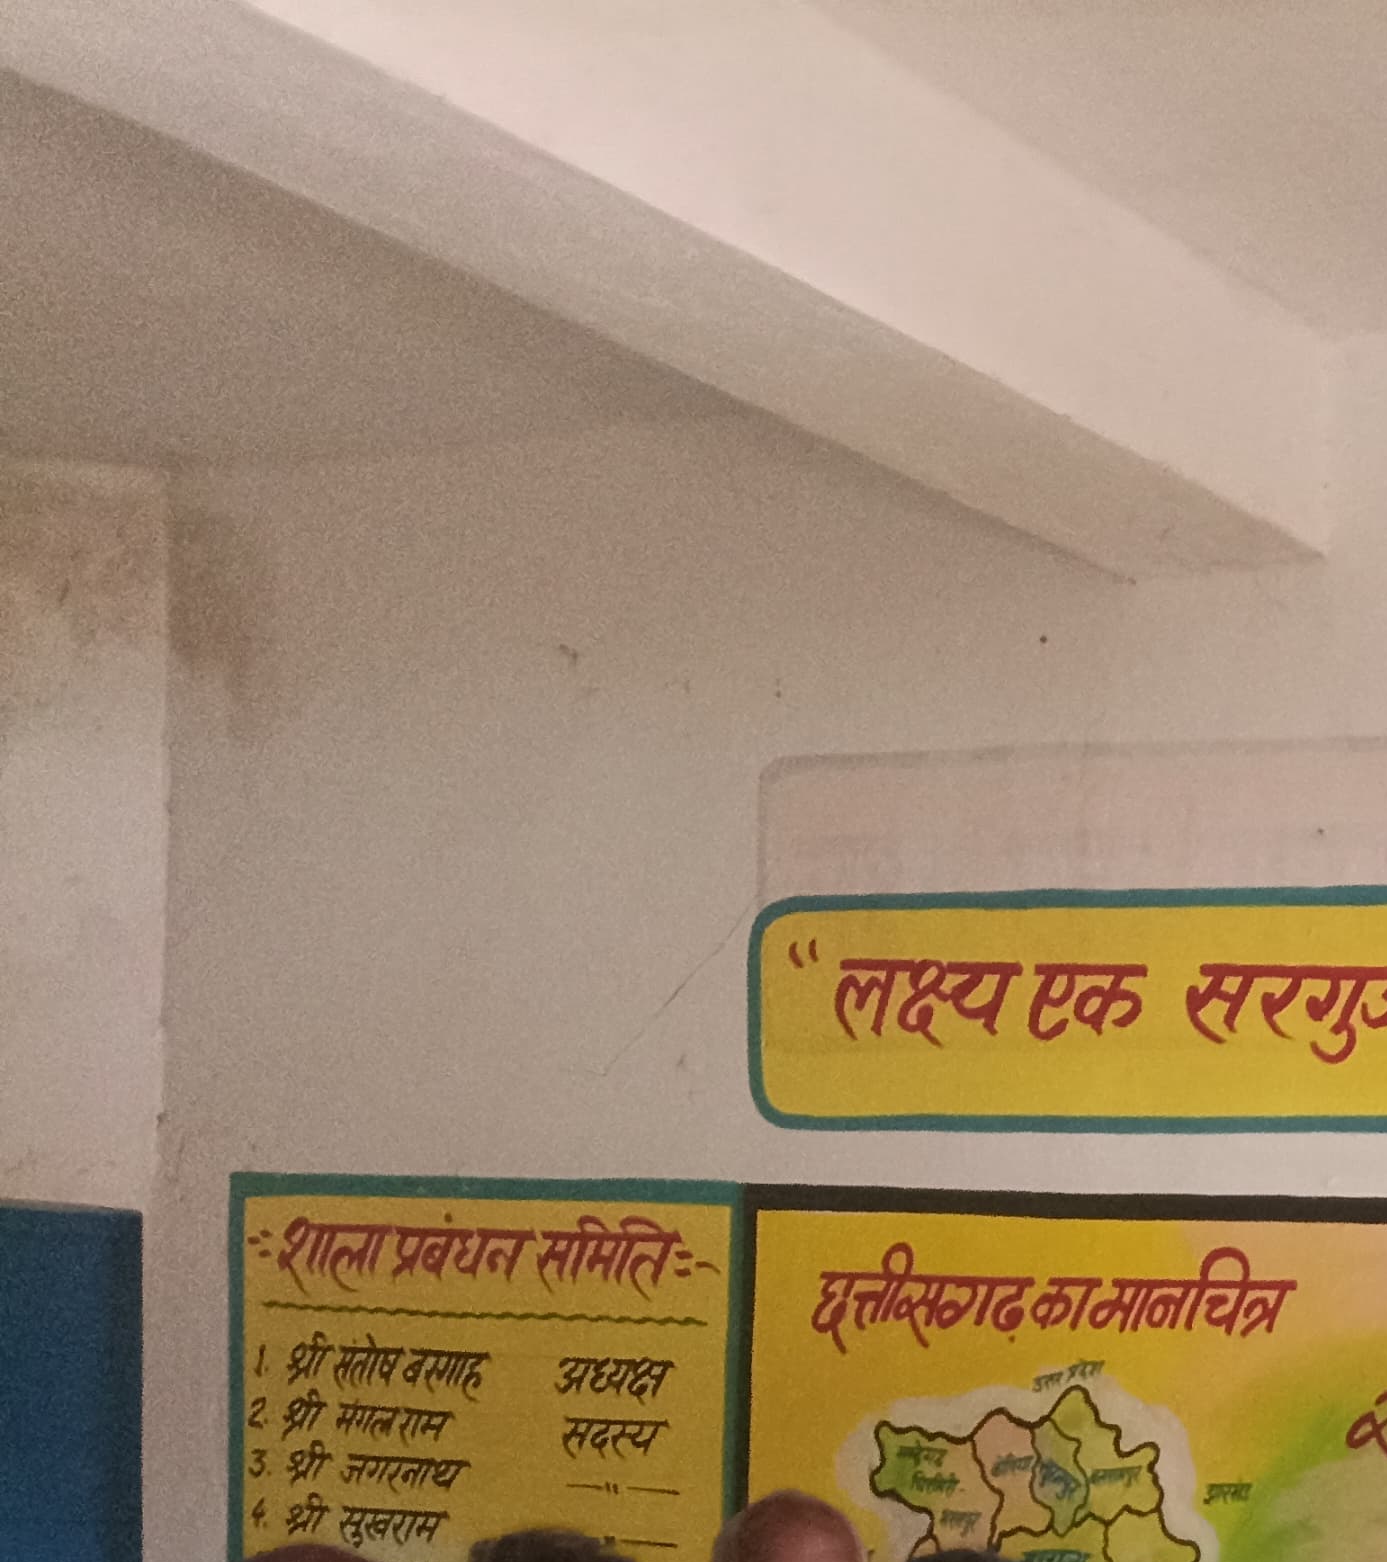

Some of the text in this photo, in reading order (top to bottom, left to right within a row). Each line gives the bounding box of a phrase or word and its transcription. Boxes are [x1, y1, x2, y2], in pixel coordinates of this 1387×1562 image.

[1026, 963, 1148, 1041] एक
[1031, 1276, 1102, 1331] का
[1088, 1246, 1297, 1337] मानचित्र
[287, 1331, 335, 1386] श्री
[554, 1356, 675, 1406] अध्यक्ष
[281, 1389, 327, 1441] श्री
[399, 1407, 456, 1448] राम
[562, 1416, 670, 1459] सदस्य
[285, 1440, 332, 1486] श्री
[285, 1492, 330, 1536] श्री
[338, 1505, 449, 1549] सुखराम
